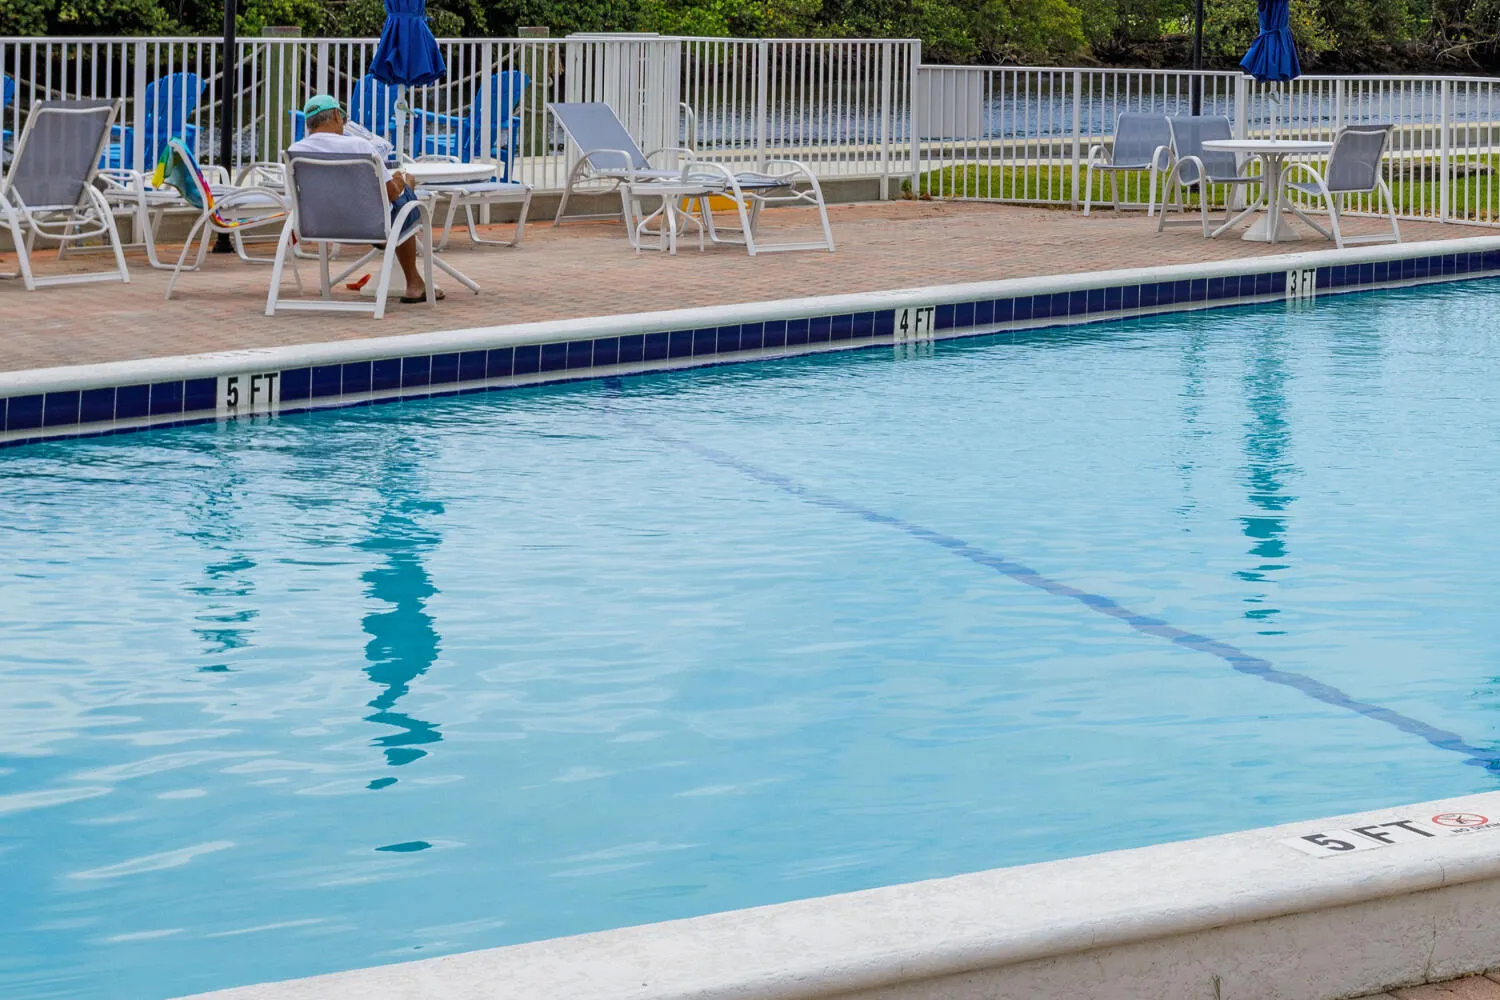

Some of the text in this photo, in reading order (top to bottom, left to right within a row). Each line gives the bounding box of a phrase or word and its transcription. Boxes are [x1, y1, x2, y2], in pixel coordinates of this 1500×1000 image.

[1291, 268, 1315, 293] 3 FT
[900, 307, 934, 334] 4 FT
[227, 372, 278, 407] 5 FT
[1301, 820, 1435, 851] 5 FT
